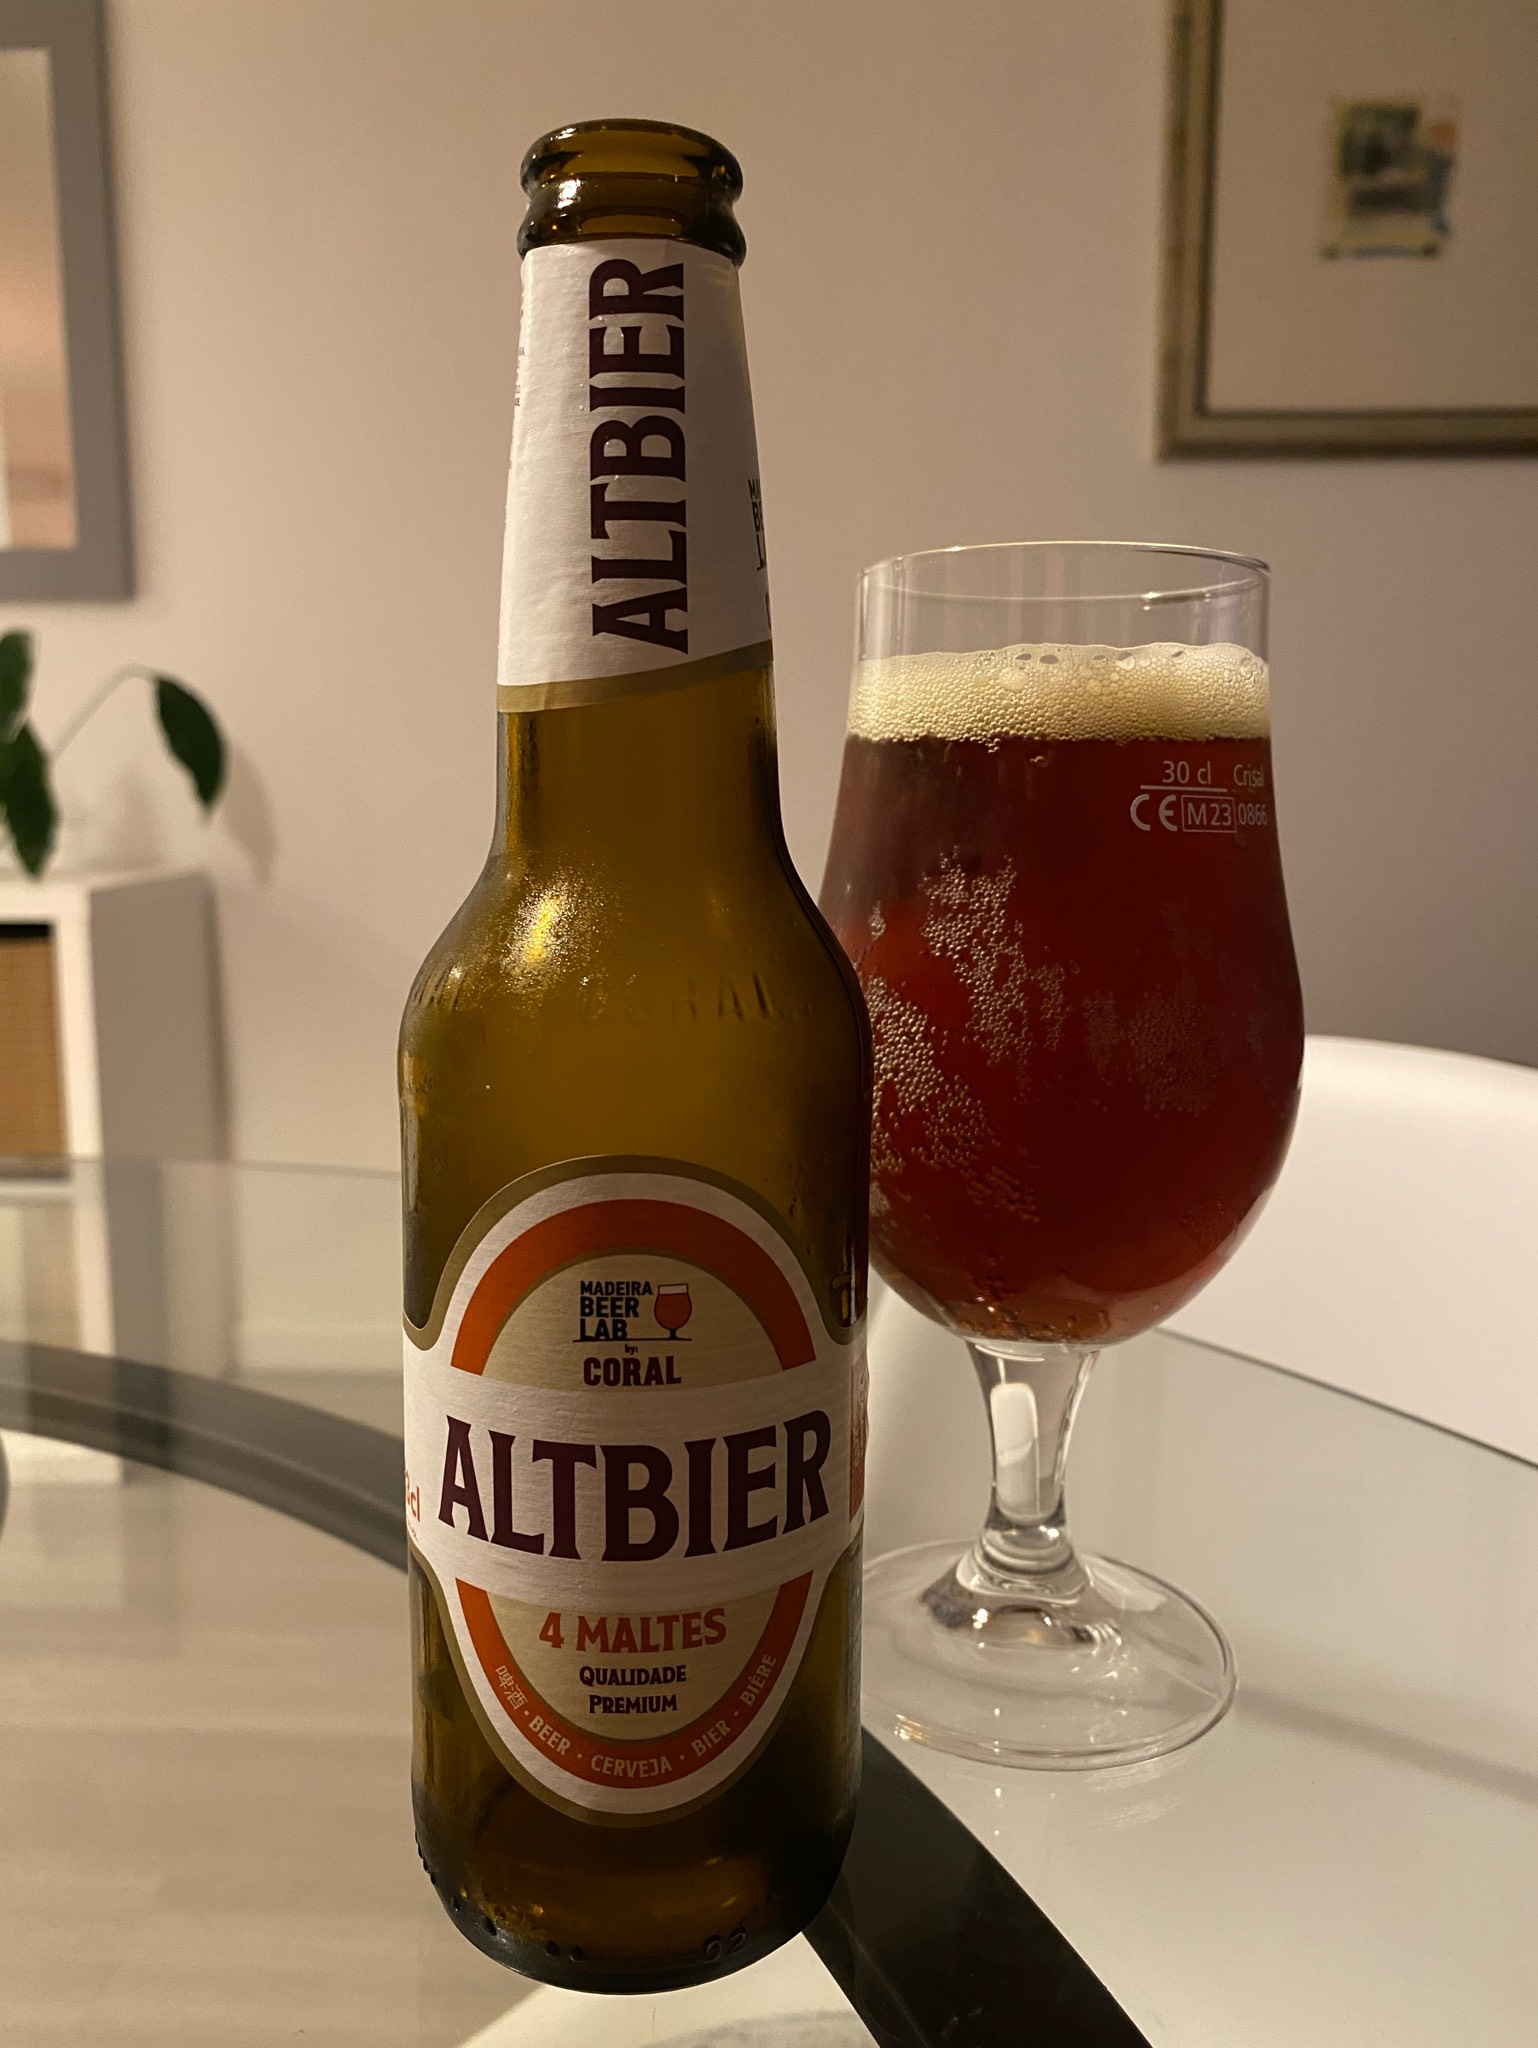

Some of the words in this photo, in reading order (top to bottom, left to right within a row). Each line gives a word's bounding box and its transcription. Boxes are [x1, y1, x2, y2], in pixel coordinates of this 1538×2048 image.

[589, 258, 689, 655] ALTBIER
[1162, 761, 1190, 784] 30
[1197, 761, 1212, 785] cl
[1238, 803, 1268, 826] 0866
[580, 1280, 653, 1296] MADEIRA
[580, 1296, 640, 1318] BEER
[580, 1318, 628, 1340] LAB
[624, 1343, 639, 1355] by:
[583, 1356, 682, 1386] CORAL
[438, 1410, 831, 1562] ALTBIER
[539, 1612, 565, 1649] 4
[576, 1607, 727, 1653] MALTES
[579, 1664, 687, 1686] QUALIDADE
[496, 1665, 528, 1709] 啤酒
[528, 1715, 571, 1756] BEER
[591, 1754, 673, 1778] CERVEJA
[691, 1719, 731, 1757] BIER
[740, 1653, 777, 1707] BIÈRE
[589, 1694, 678, 1714] PREMIUM
